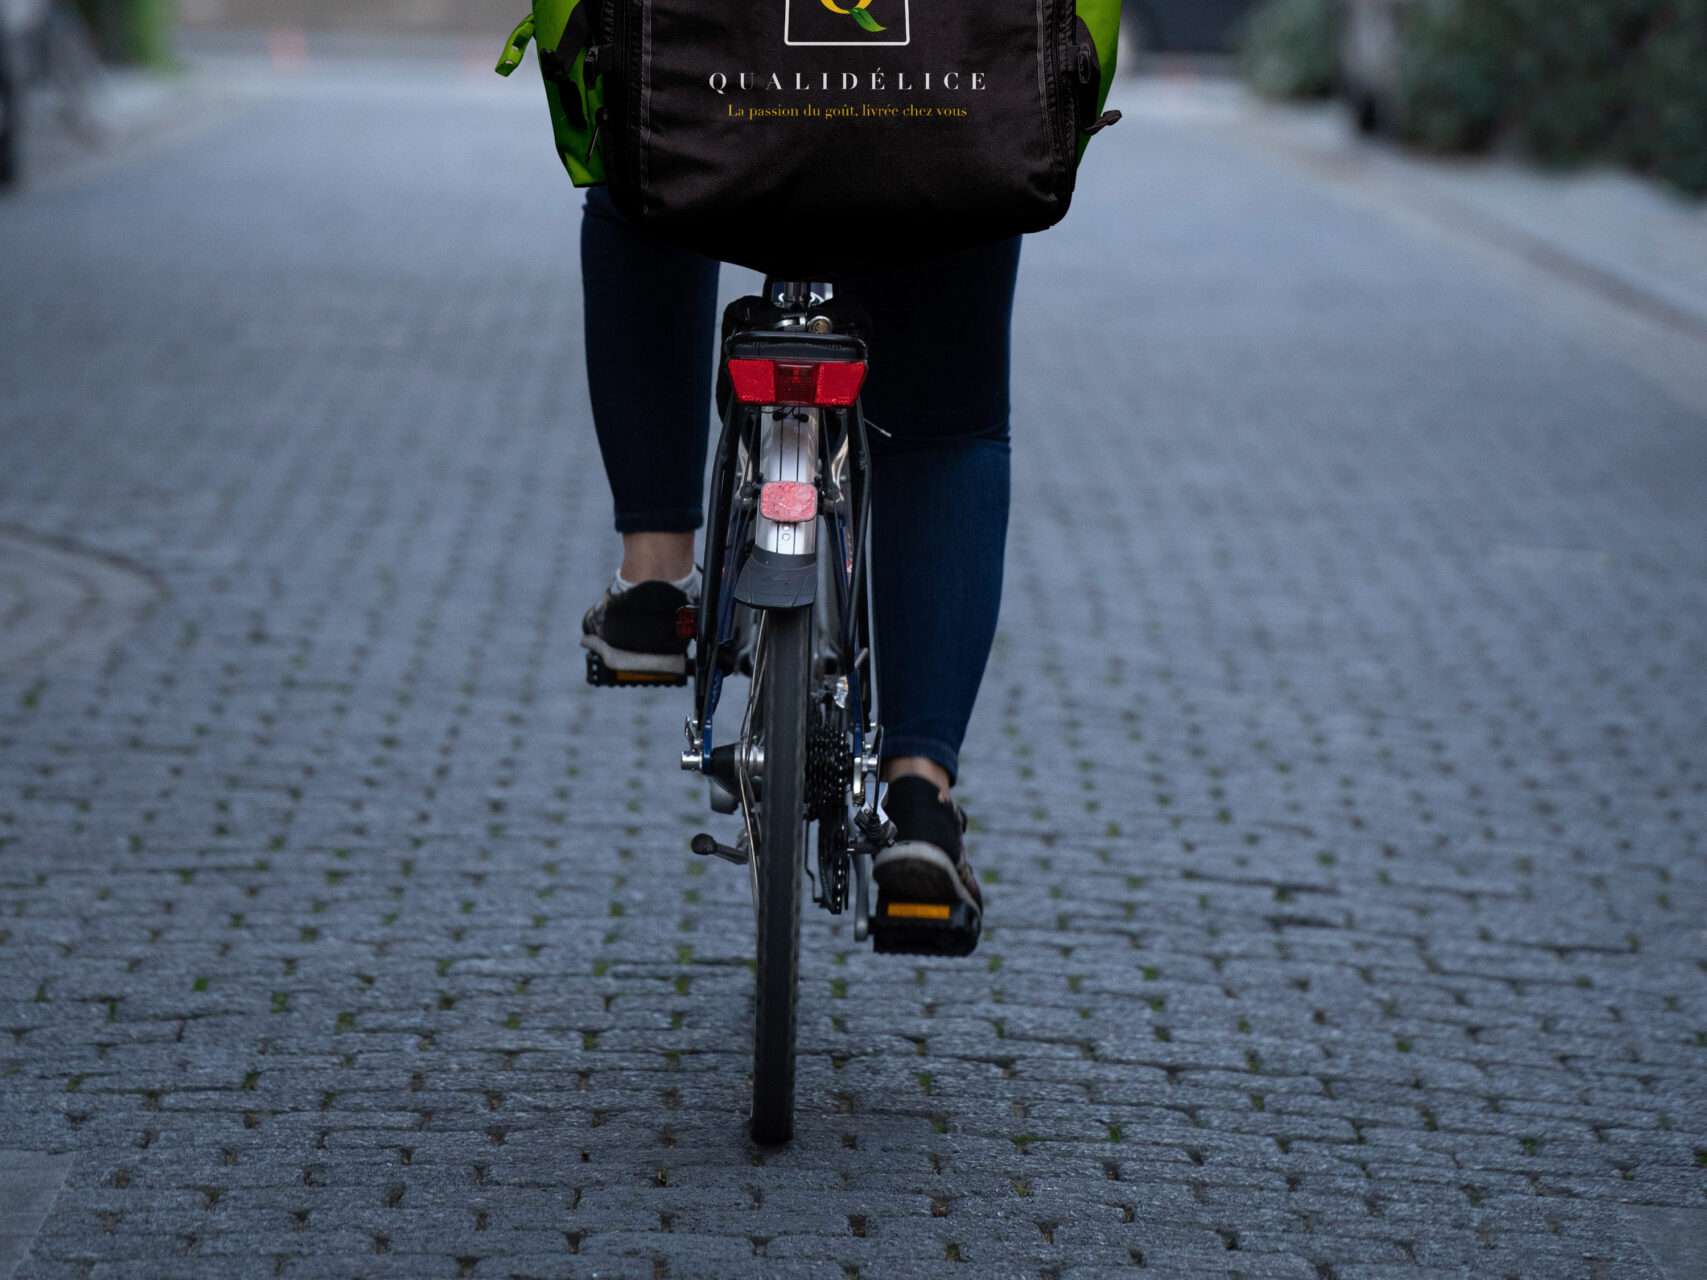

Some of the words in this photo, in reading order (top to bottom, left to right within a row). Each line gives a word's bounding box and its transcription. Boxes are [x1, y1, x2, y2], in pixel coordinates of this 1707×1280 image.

[708, 67, 987, 95] QUALIDÉLICE
[727, 103, 744, 117] La
[748, 103, 799, 121] passion
[803, 103, 821, 117] du
[861, 103, 899, 117] livrée
[902, 103, 932, 117] chez
[936, 106, 968, 117] vous
